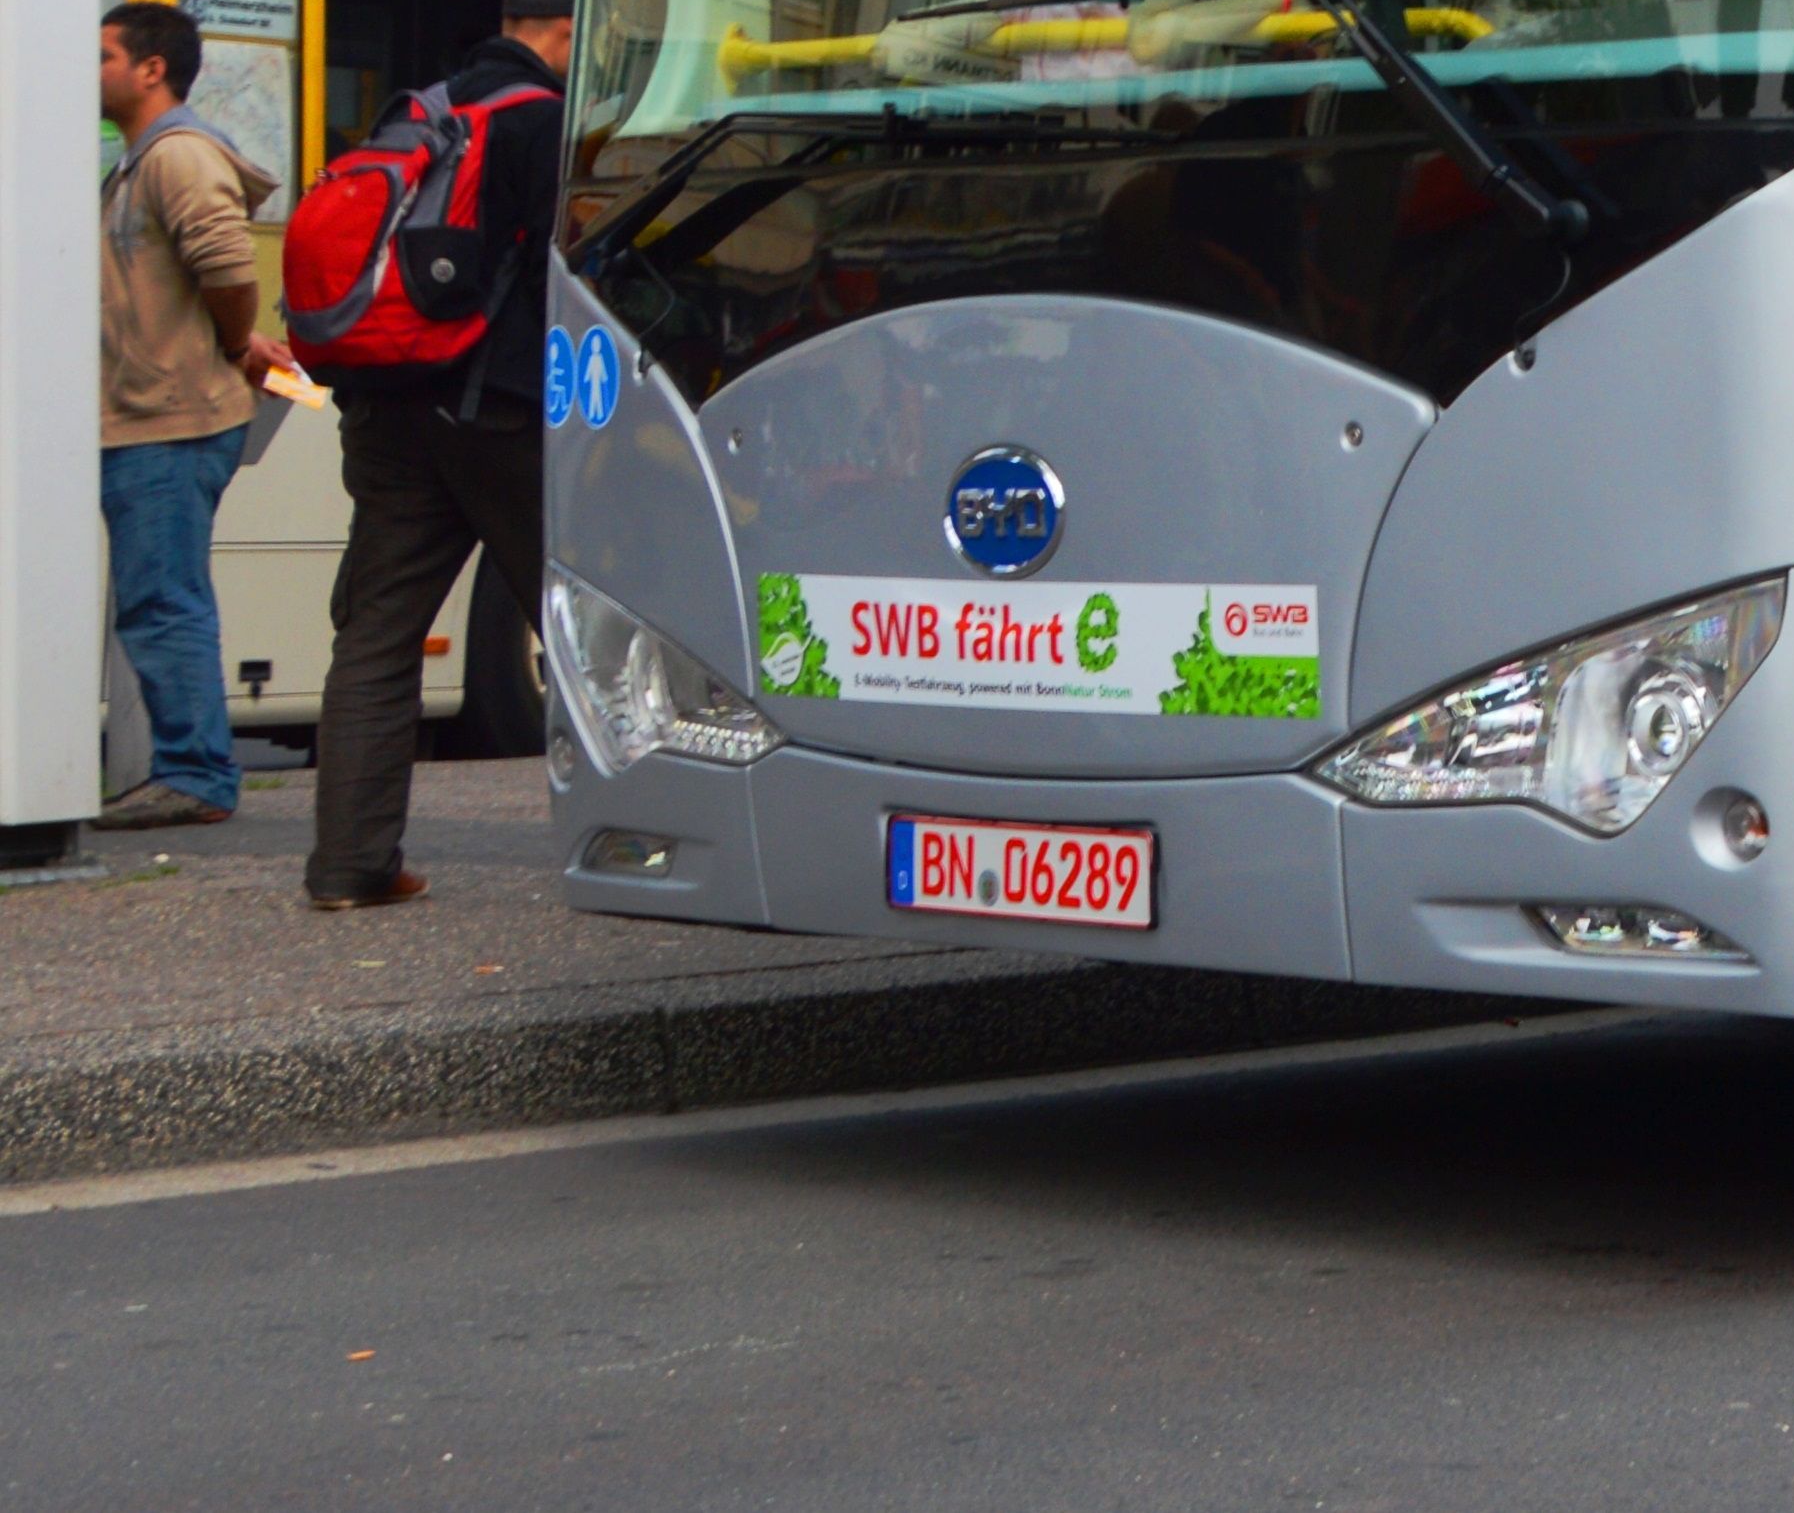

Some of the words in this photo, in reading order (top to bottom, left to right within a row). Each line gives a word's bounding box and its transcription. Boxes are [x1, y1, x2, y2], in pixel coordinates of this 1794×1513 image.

[852, 600, 941, 660] SWB
[955, 601, 1065, 665] fährt
[1075, 592, 1120, 673] e
[1253, 604, 1308, 624] SWB
[921, 831, 974, 899] BN
[1004, 837, 1139, 912] 06289
